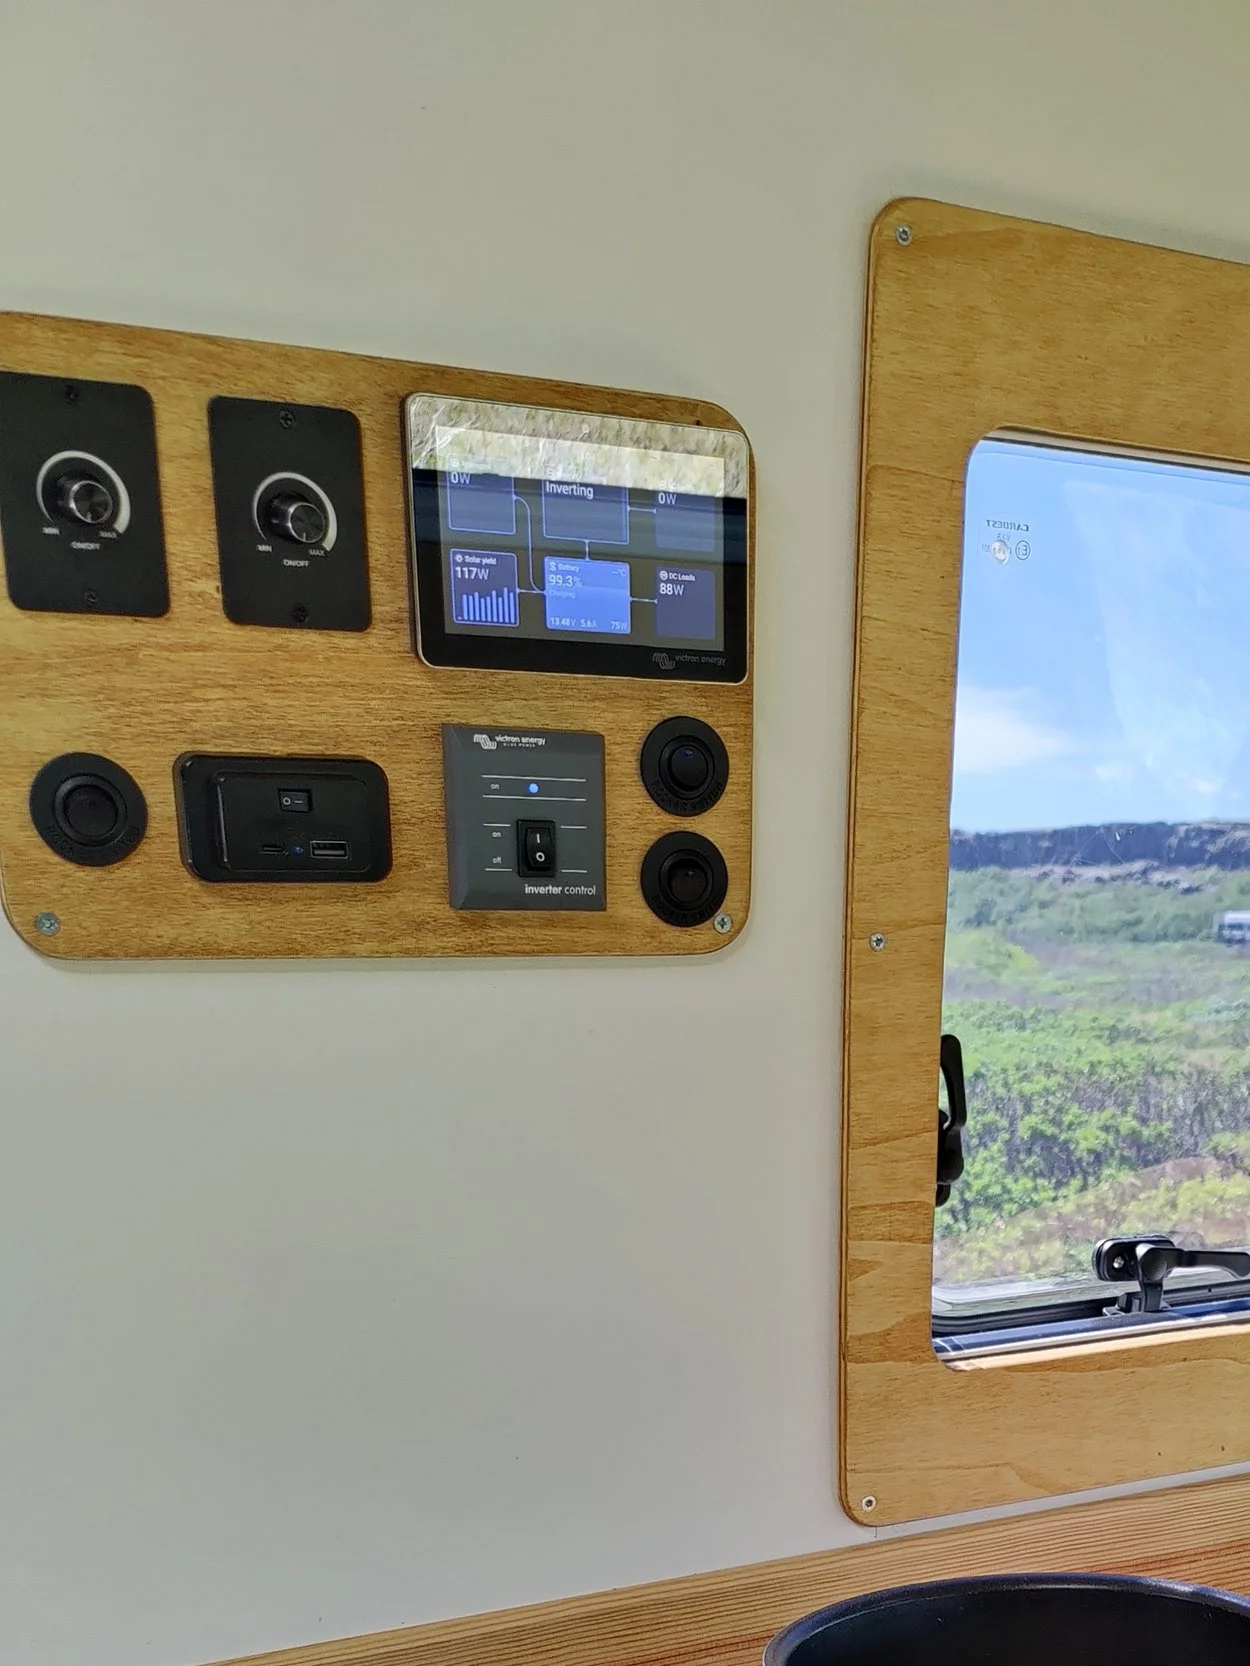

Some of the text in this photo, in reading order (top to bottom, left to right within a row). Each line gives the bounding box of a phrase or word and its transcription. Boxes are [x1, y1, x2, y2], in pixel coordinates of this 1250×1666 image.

[450, 471, 471, 485] 0W
[545, 482, 594, 499] Inverting
[658, 492, 677, 505] 0W
[257, 544, 273, 553] MIN
[309, 549, 325, 557] MAX
[283, 559, 310, 568] ON/OFF
[455, 567, 489, 580] 117W
[669, 572, 696, 582] DC Loads
[549, 574, 583, 588] 99.3%
[659, 583, 684, 596] 88W
[674, 654, 727, 666] victron energy
[495, 734, 546, 746] victron energy
[492, 857, 502, 865] off
[524, 883, 596, 896] inverter control
